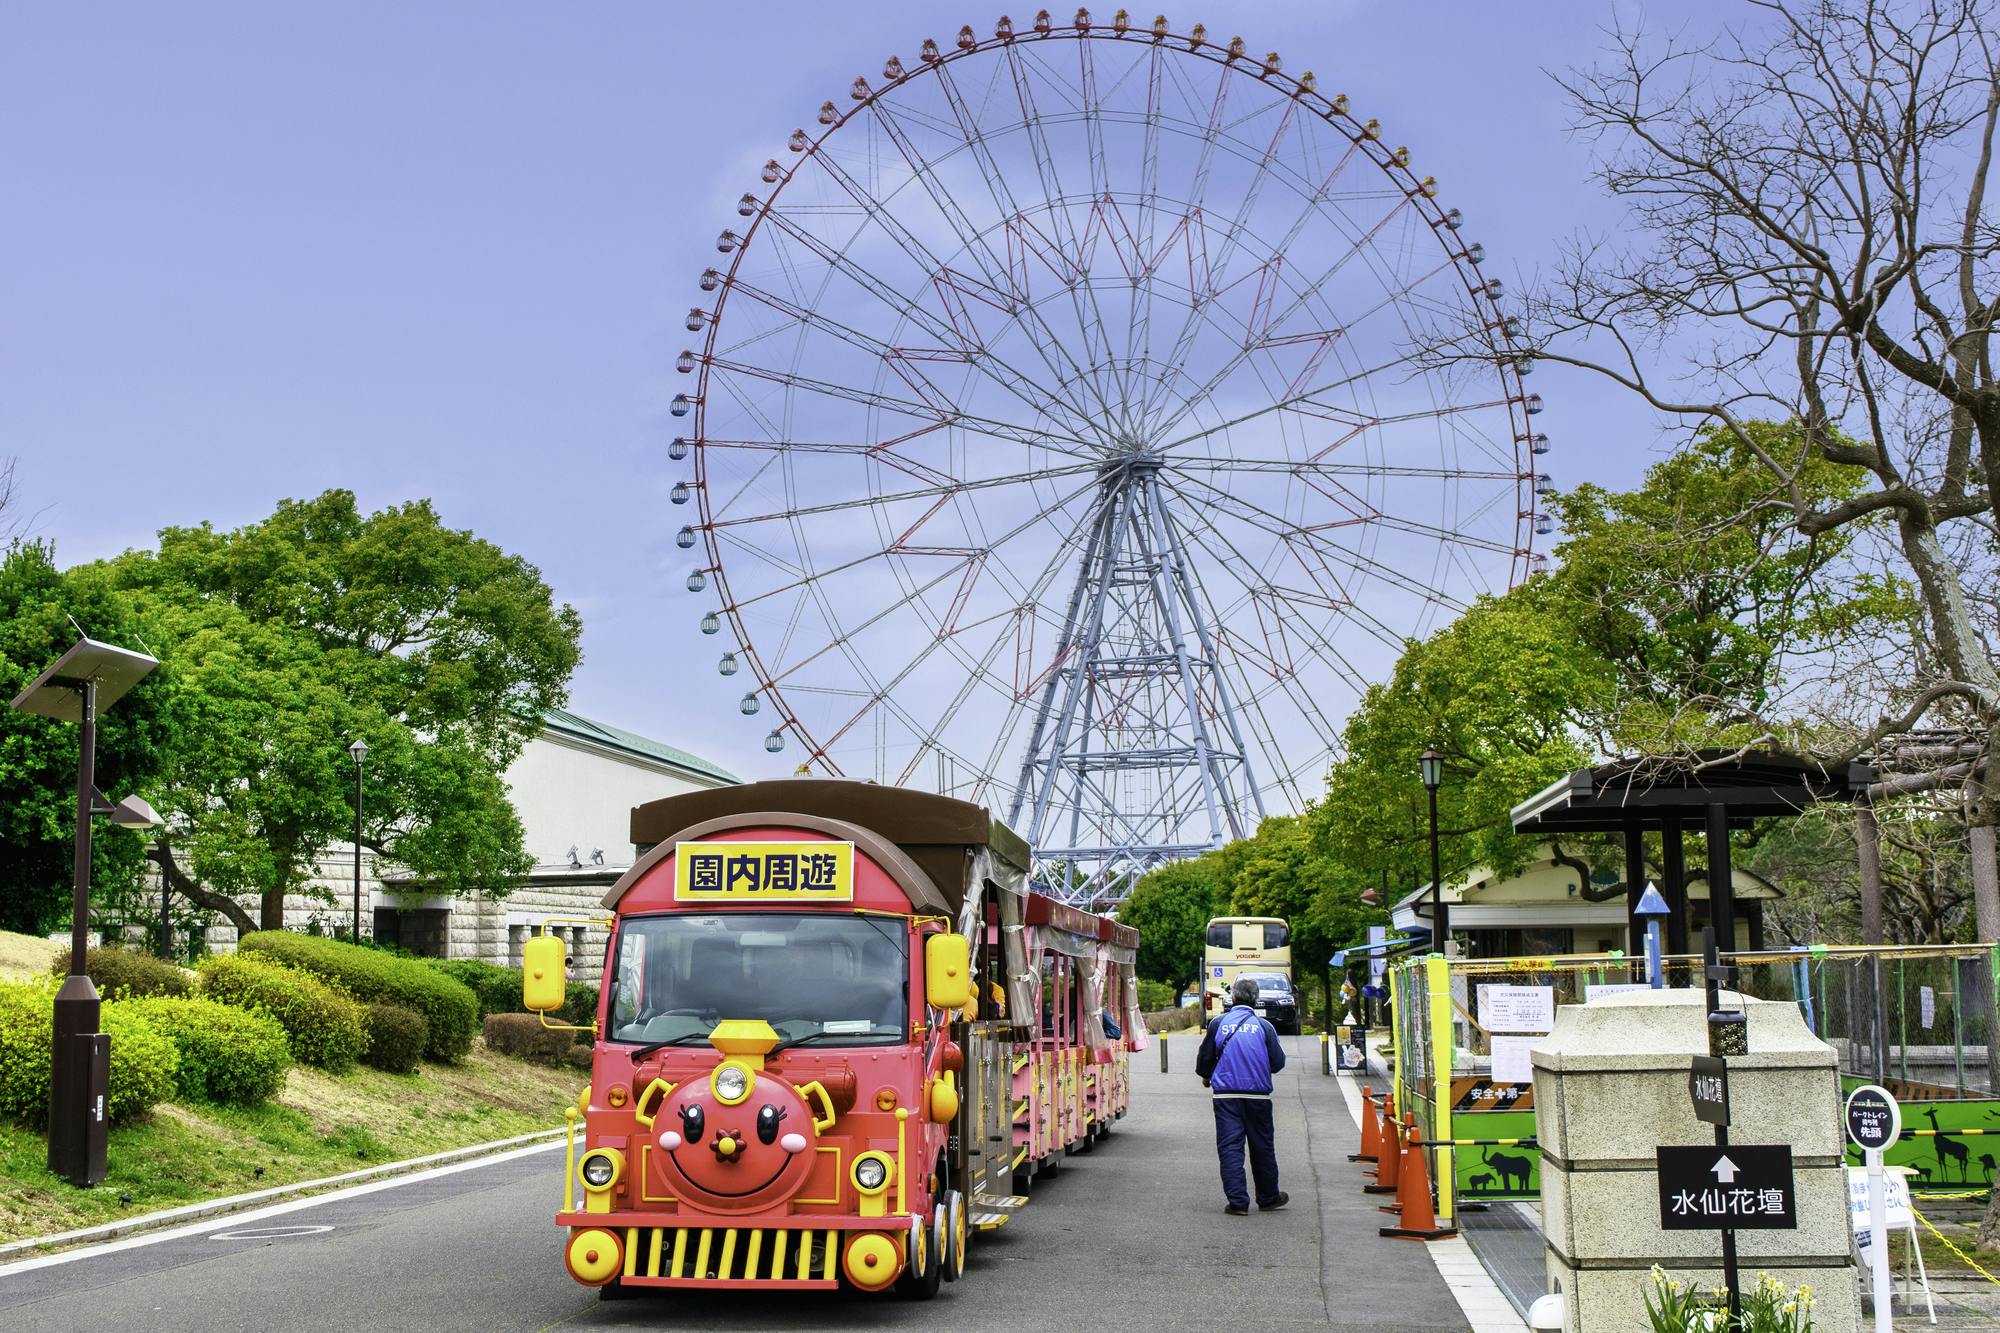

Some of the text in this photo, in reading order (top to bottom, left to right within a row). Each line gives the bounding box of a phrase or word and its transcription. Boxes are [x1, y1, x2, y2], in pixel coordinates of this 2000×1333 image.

[689, 854, 836, 891] 園内周遊
[1222, 1023, 1259, 1035] STAFF
[1695, 1074, 1723, 1103] 水仙花壇
[1861, 1127, 1882, 1138] 先頭
[1671, 1187, 1785, 1215] 水仙花壇
